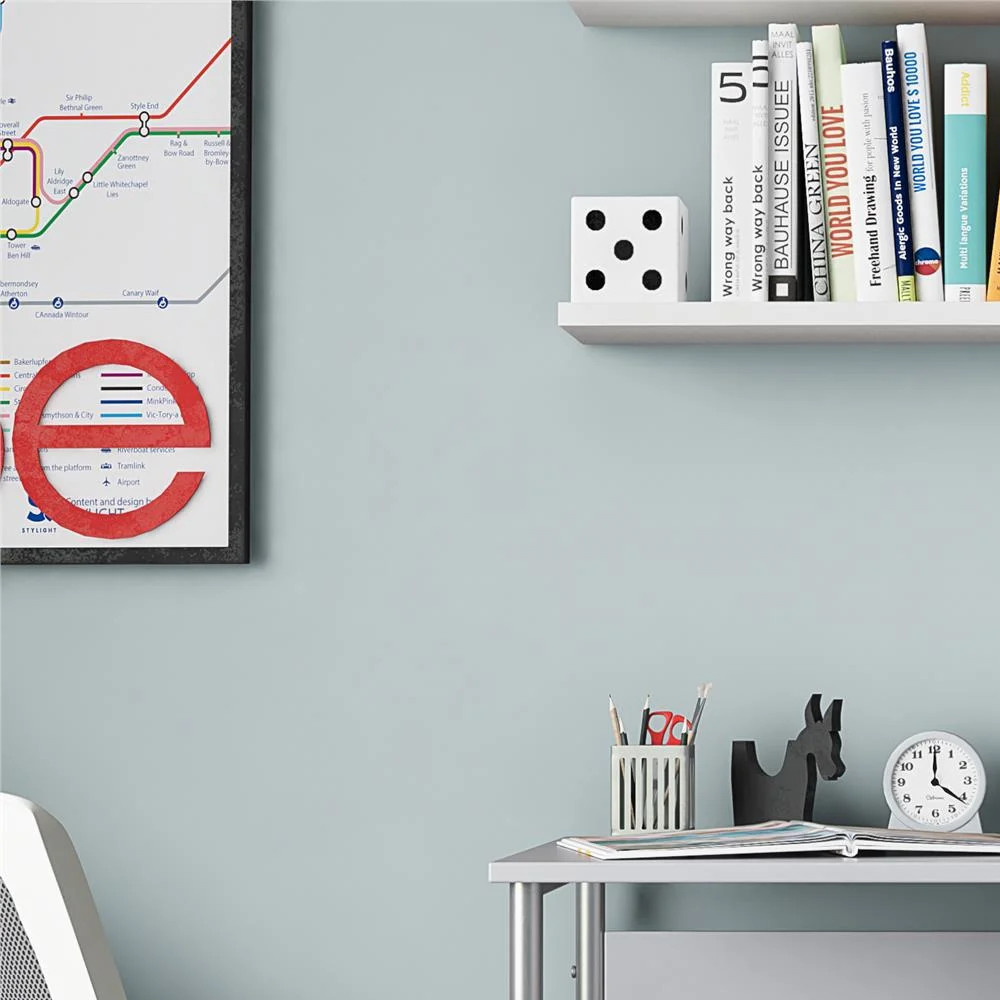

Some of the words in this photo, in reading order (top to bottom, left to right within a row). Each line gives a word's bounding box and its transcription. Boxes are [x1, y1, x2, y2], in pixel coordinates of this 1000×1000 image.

[904, 51, 918, 85] 10000
[76, 94, 93, 102] Philip
[720, 72, 746, 103] 5
[774, 80, 789, 152] ISSUEE
[906, 99, 922, 124] LOVE
[821, 105, 846, 148] LOVE
[889, 126, 899, 155] World
[909, 129, 924, 151] YOU
[805, 143, 823, 214] GREEN
[824, 153, 849, 190] YOU
[865, 162, 873, 172] for
[892, 158, 901, 177] New
[910, 155, 926, 192] WORLD
[47, 178, 73, 186] Aldridge
[110, 181, 148, 189] Whitechapel
[752, 165, 763, 203] back
[960, 167, 968, 212] Variations
[2, 198, 30, 206] Aldogate
[723, 177, 733, 213] back
[862, 175, 878, 225] Drawing
[774, 160, 789, 269] BAUHAUSE
[894, 194, 904, 224] Goods
[724, 219, 735, 247] way
[754, 209, 765, 239] way
[826, 195, 853, 258] WORLD
[960, 214, 971, 244] langue
[894, 228, 908, 259] Alergic
[753, 244, 765, 291] Wrong
[811, 222, 828, 295] CHINA
[866, 230, 882, 287] Freehand
[960, 247, 968, 269] Multi
[723, 252, 735, 297] Wrong
[80, 411, 94, 419] City
[64, 464, 91, 472] platform
[118, 462, 145, 470] Tramlink
[117, 478, 140, 487] Airport
[100, 498, 116, 506] and
[117, 498, 144, 508] design
[901, 762, 914, 771] 10
[912, 750, 922, 759] 11
[949, 750, 953, 758] 1
[959, 761, 967, 769] 2
[897, 778, 906, 787] 9
[963, 776, 972, 785] 3
[903, 794, 911, 803] 8
[915, 805, 923, 814] 7
[948, 804, 956, 813] 5
[931, 809, 940, 818] 6
